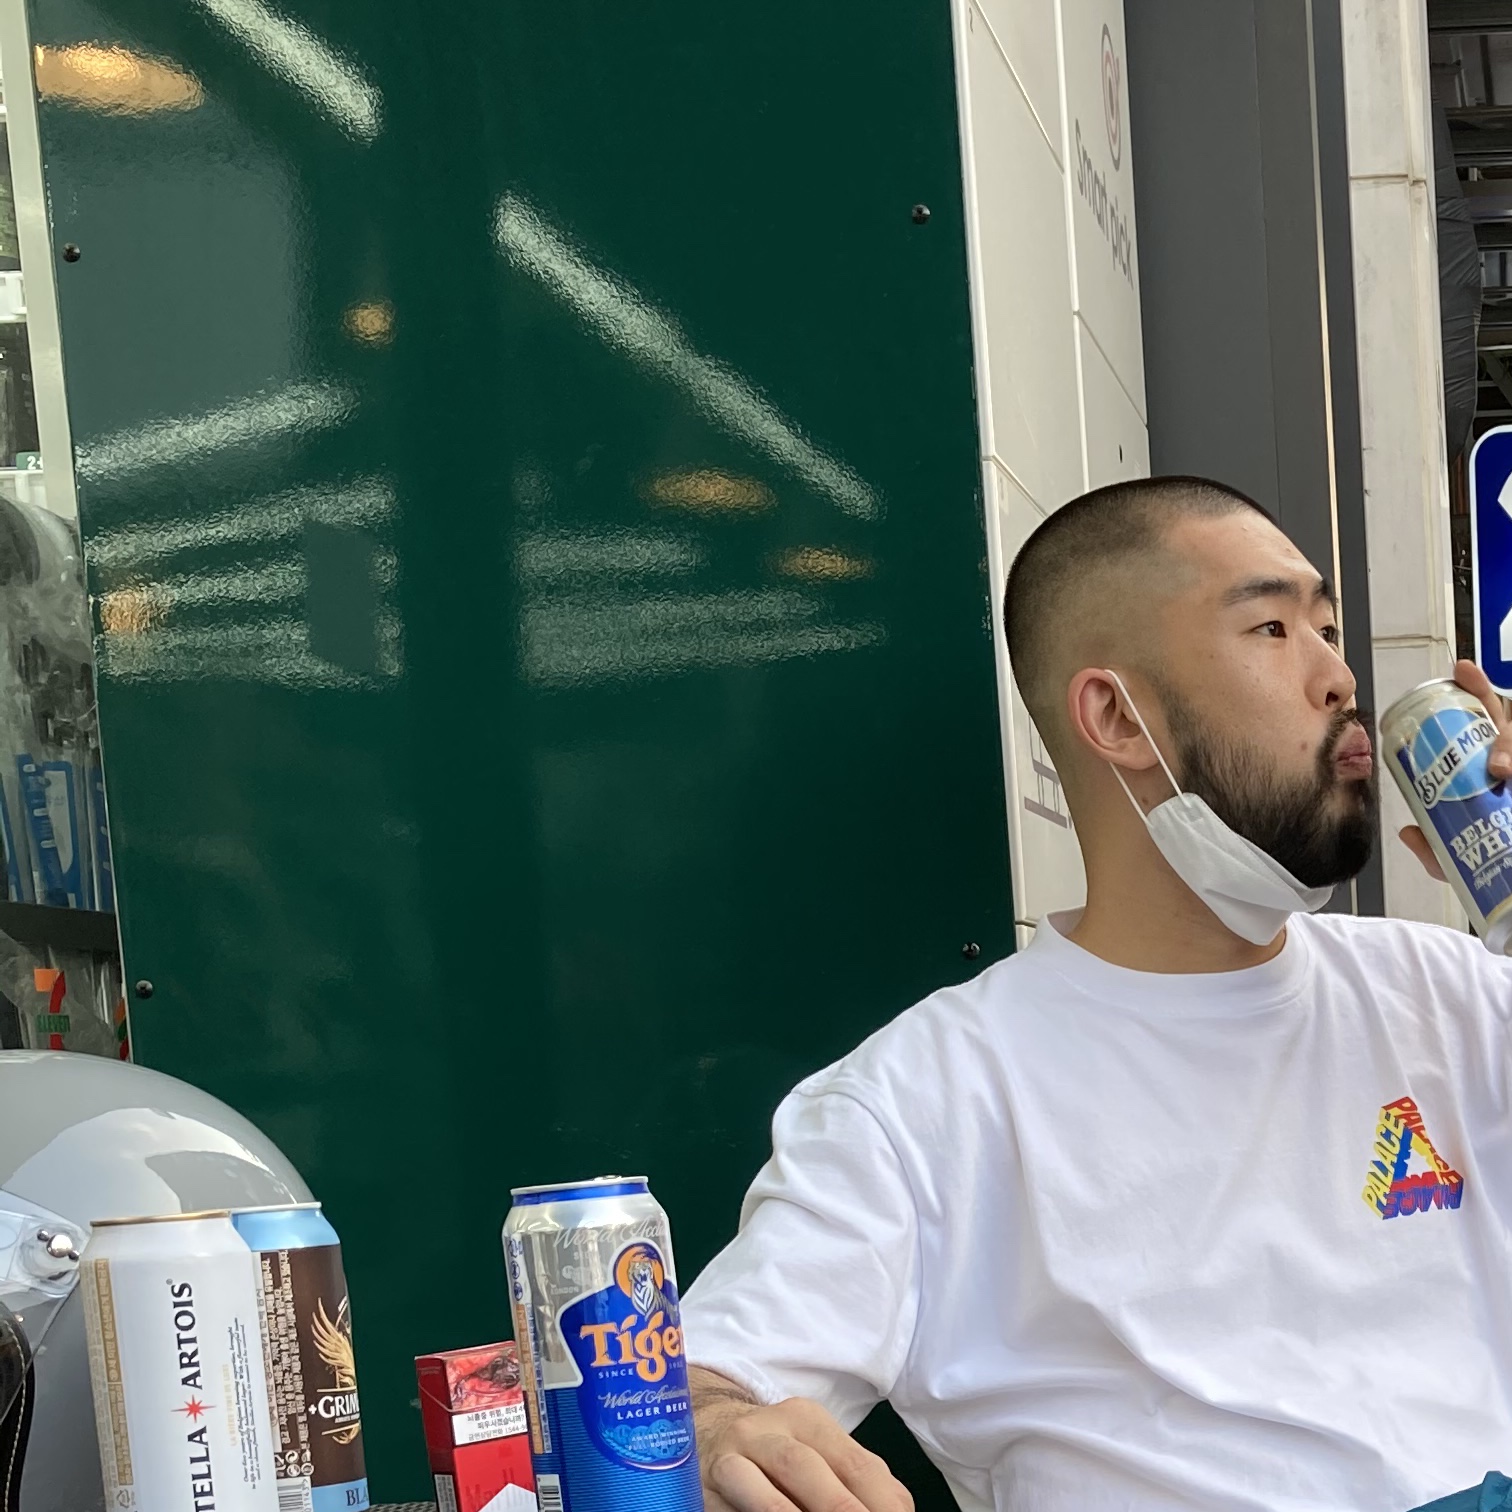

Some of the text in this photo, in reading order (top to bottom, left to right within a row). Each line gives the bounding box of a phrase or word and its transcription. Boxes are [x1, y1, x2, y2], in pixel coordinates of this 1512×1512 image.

[1075, 118, 1134, 290] Smart pick
[1418, 719, 1500, 805] BLUE MOON
[1362, 1106, 1405, 1220] PALACE
[171, 1281, 204, 1391] ARTOIS
[598, 1368, 634, 1380] SINCE
[617, 1402, 688, 1421] LAGER BEER
